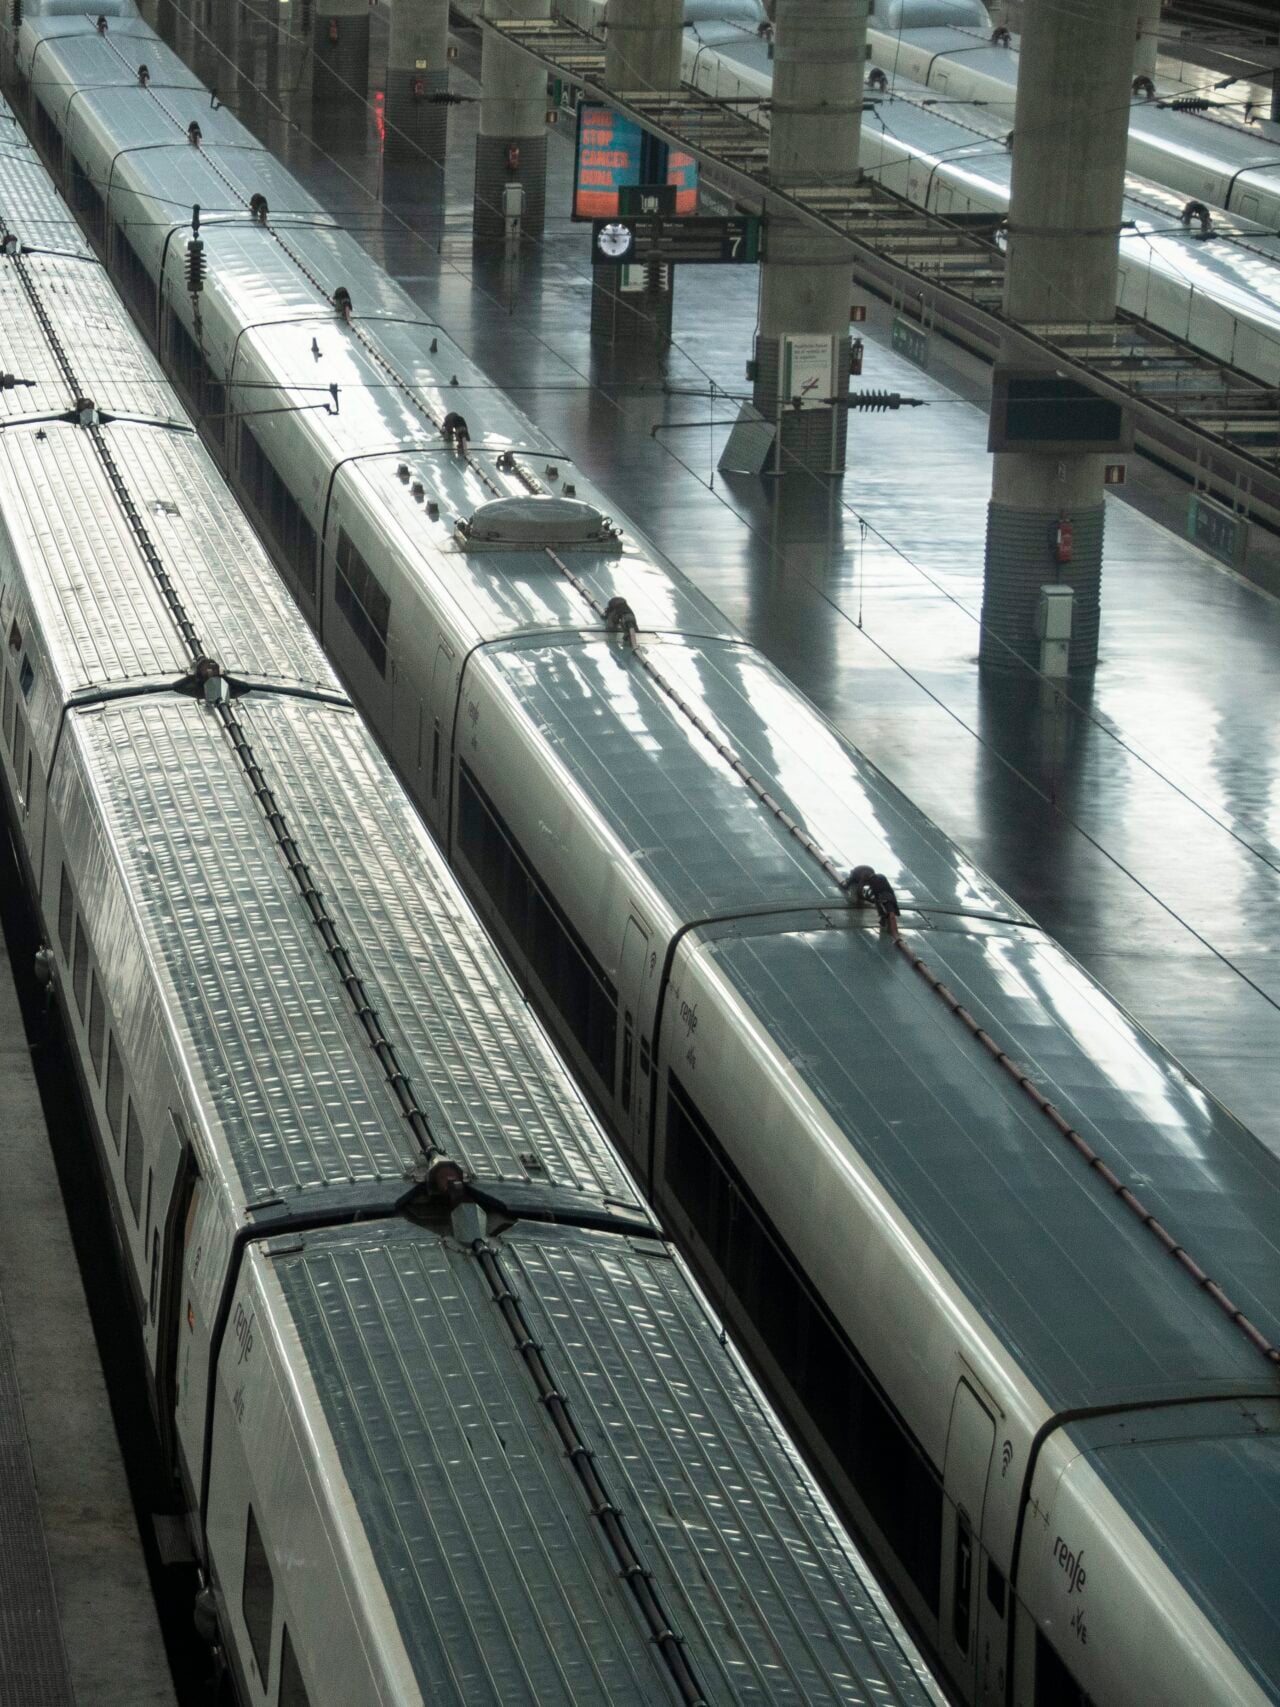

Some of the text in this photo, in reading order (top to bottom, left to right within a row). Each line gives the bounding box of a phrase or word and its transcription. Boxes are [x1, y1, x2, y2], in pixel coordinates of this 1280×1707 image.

[729, 236, 742, 257] 7
[679, 1001, 699, 1038] renfe
[233, 1301, 255, 1365] renfe
[1053, 1536, 1086, 1593] renfe
